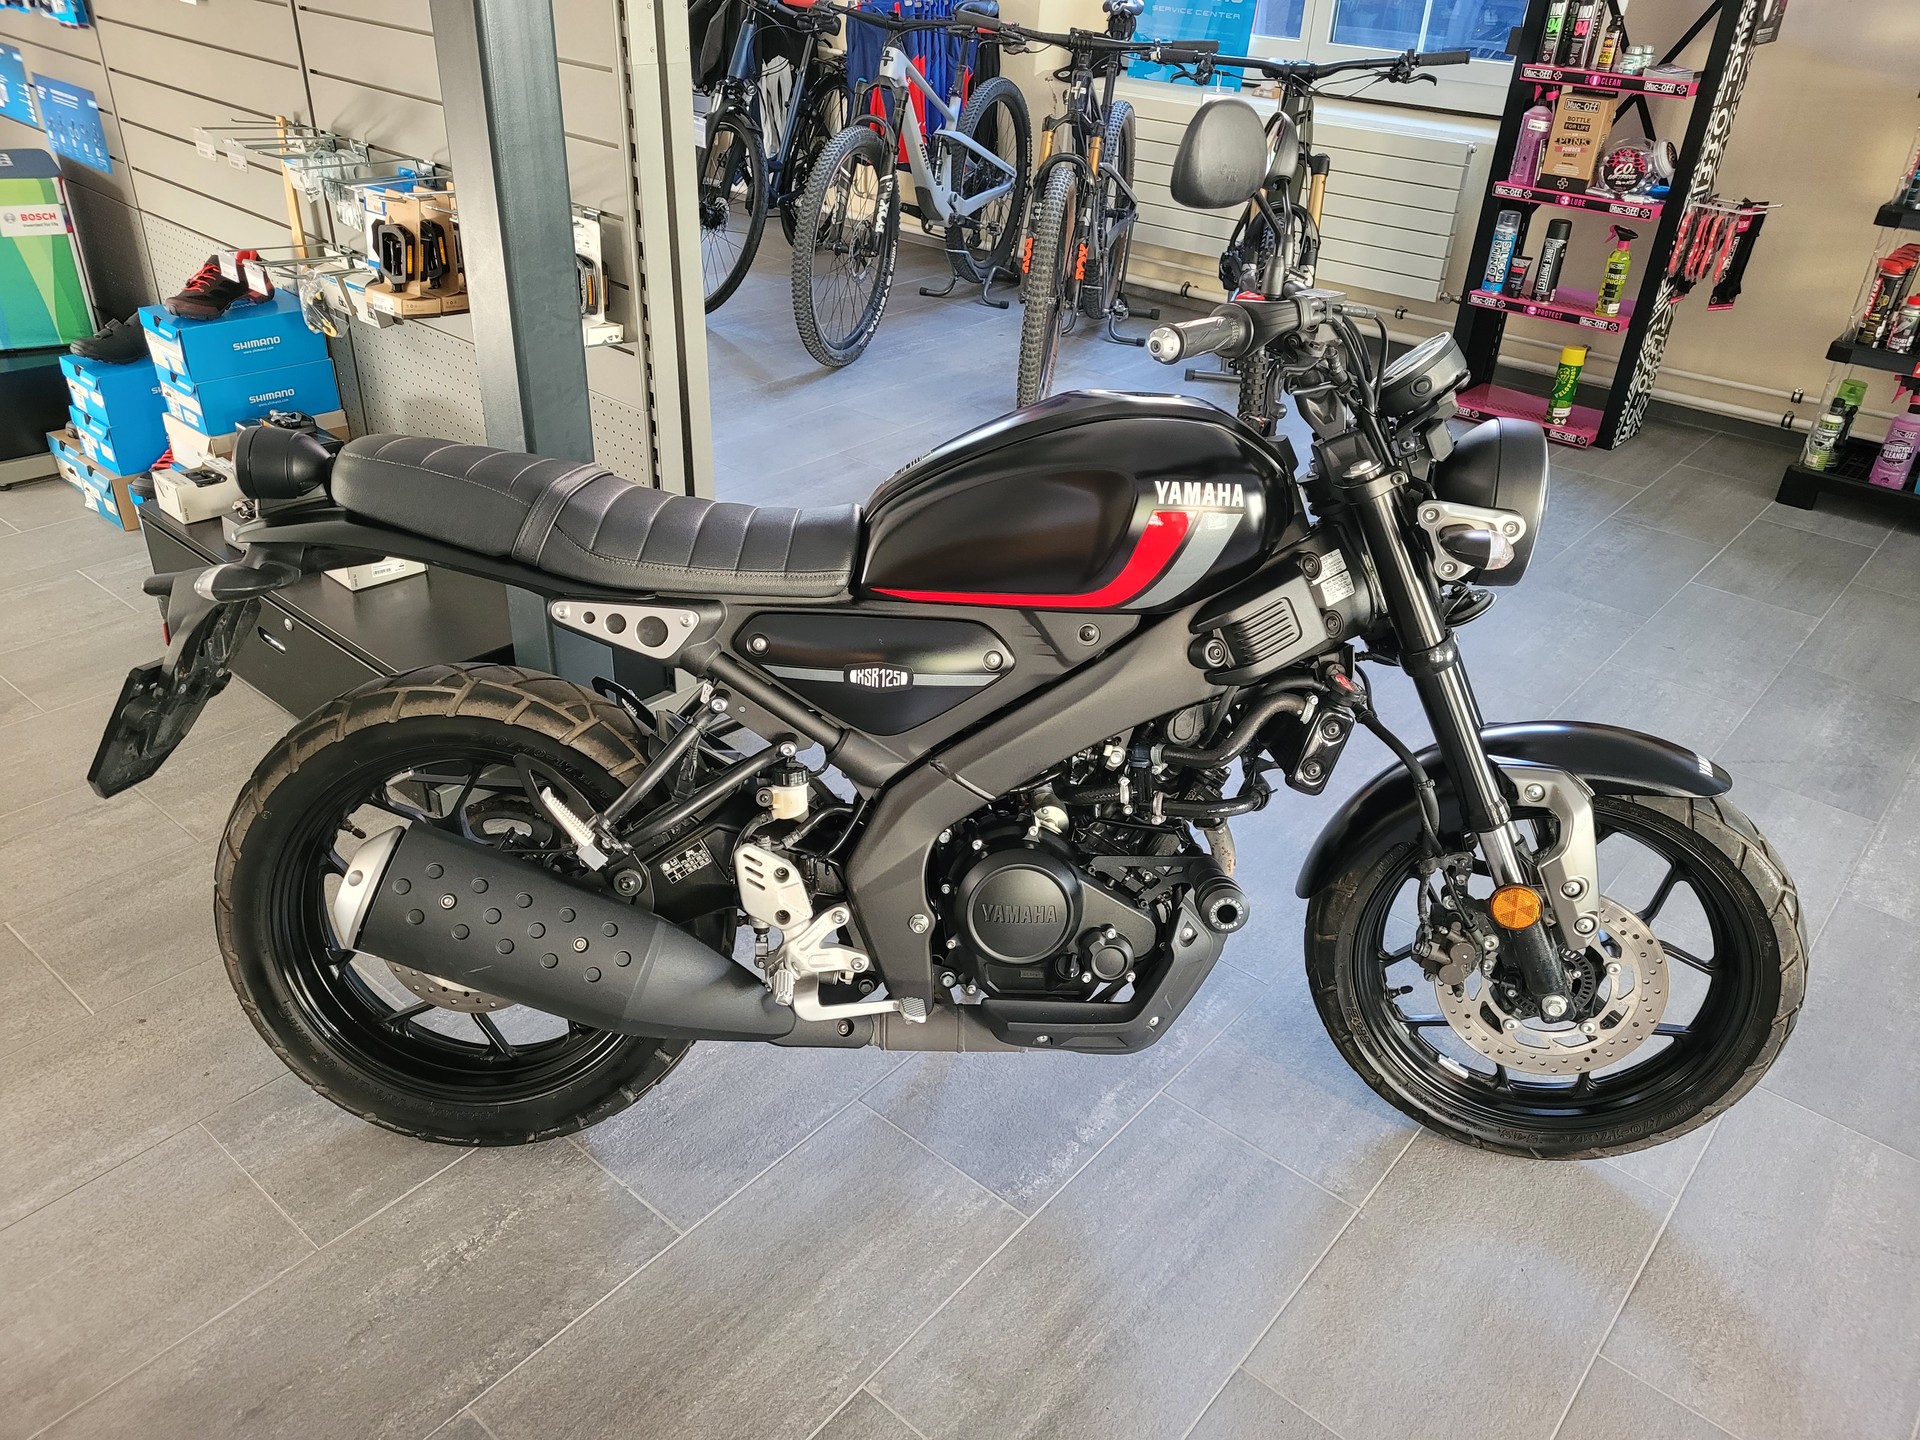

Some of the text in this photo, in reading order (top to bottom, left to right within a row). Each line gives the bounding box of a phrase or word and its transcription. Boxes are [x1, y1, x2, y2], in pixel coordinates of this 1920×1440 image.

[1152, 5, 1241, 20] SERVICE CENTER
[1546, 18, 1562, 33] 94
[1573, 21, 1590, 37] 94
[1524, 69, 1551, 79] Muc-Off
[1600, 77, 1622, 87] CLEAN
[1644, 82, 1675, 93] Muc-Off
[1566, 101, 1599, 111] Muc-Off
[1559, 137, 1588, 147] PUNK
[1495, 186, 1522, 197] Muc-Off
[1570, 198, 1586, 207] LUBE
[875, 199, 891, 233] FOX
[1609, 204, 1639, 216] Muc-Off
[20, 212, 58, 221] BOSCH
[1075, 243, 1089, 280] FOX
[1496, 242, 1512, 283] SILICON
[1537, 248, 1555, 291] BIKE PROTECT
[1470, 295, 1496, 306] Muc-Off
[1537, 308, 1563, 319] PROTECT
[1580, 317, 1608, 330] Muc-Off
[232, 336, 281, 351] SHIMANO
[248, 388, 295, 404] SHIMANO
[1550, 430, 1576, 442] Muc-Off
[1882, 450, 1909, 460] CLEANER
[1154, 480, 1244, 507] YAMAHA
[856, 667, 901, 689] XSR125
[1226, 898, 1244, 915] PARTS
[981, 904, 1057, 924] YAMAHA
[1220, 921, 1238, 929] PUIG
